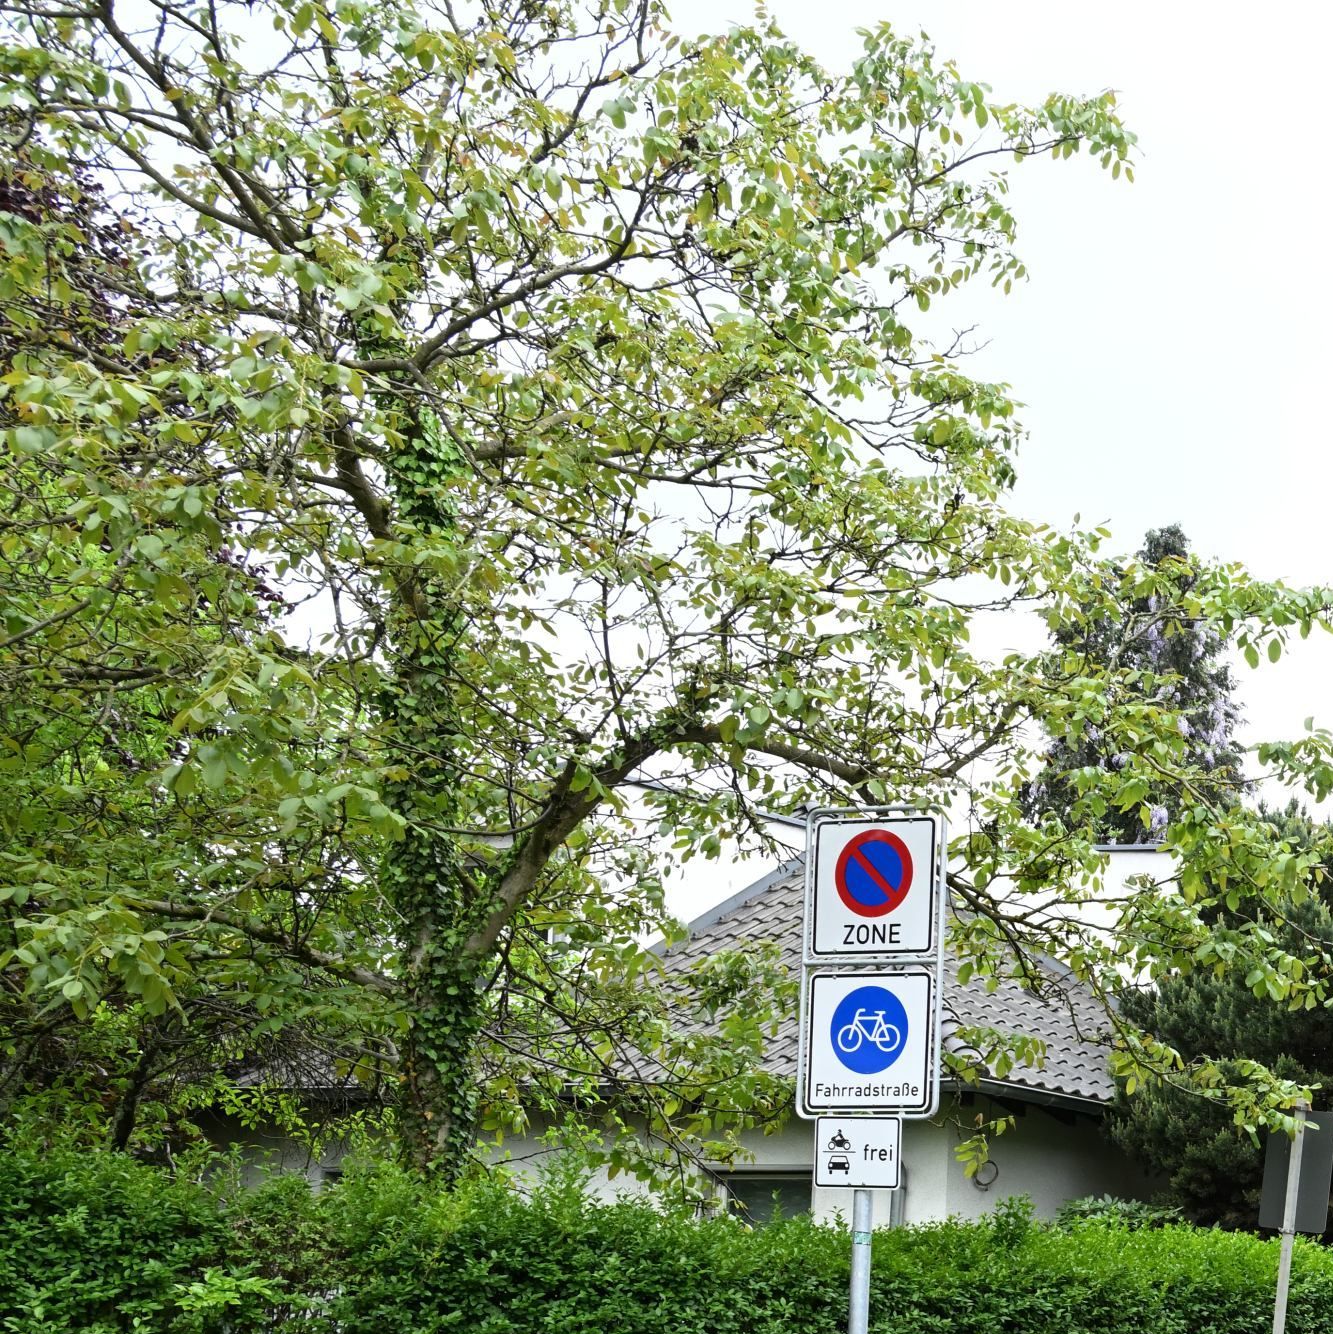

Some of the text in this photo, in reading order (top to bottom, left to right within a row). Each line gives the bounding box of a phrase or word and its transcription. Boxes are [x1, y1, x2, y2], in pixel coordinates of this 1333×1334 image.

[842, 922, 903, 946] ZONE
[814, 1081, 920, 1100] Fahrradstraße
[862, 1142, 894, 1164] frei
